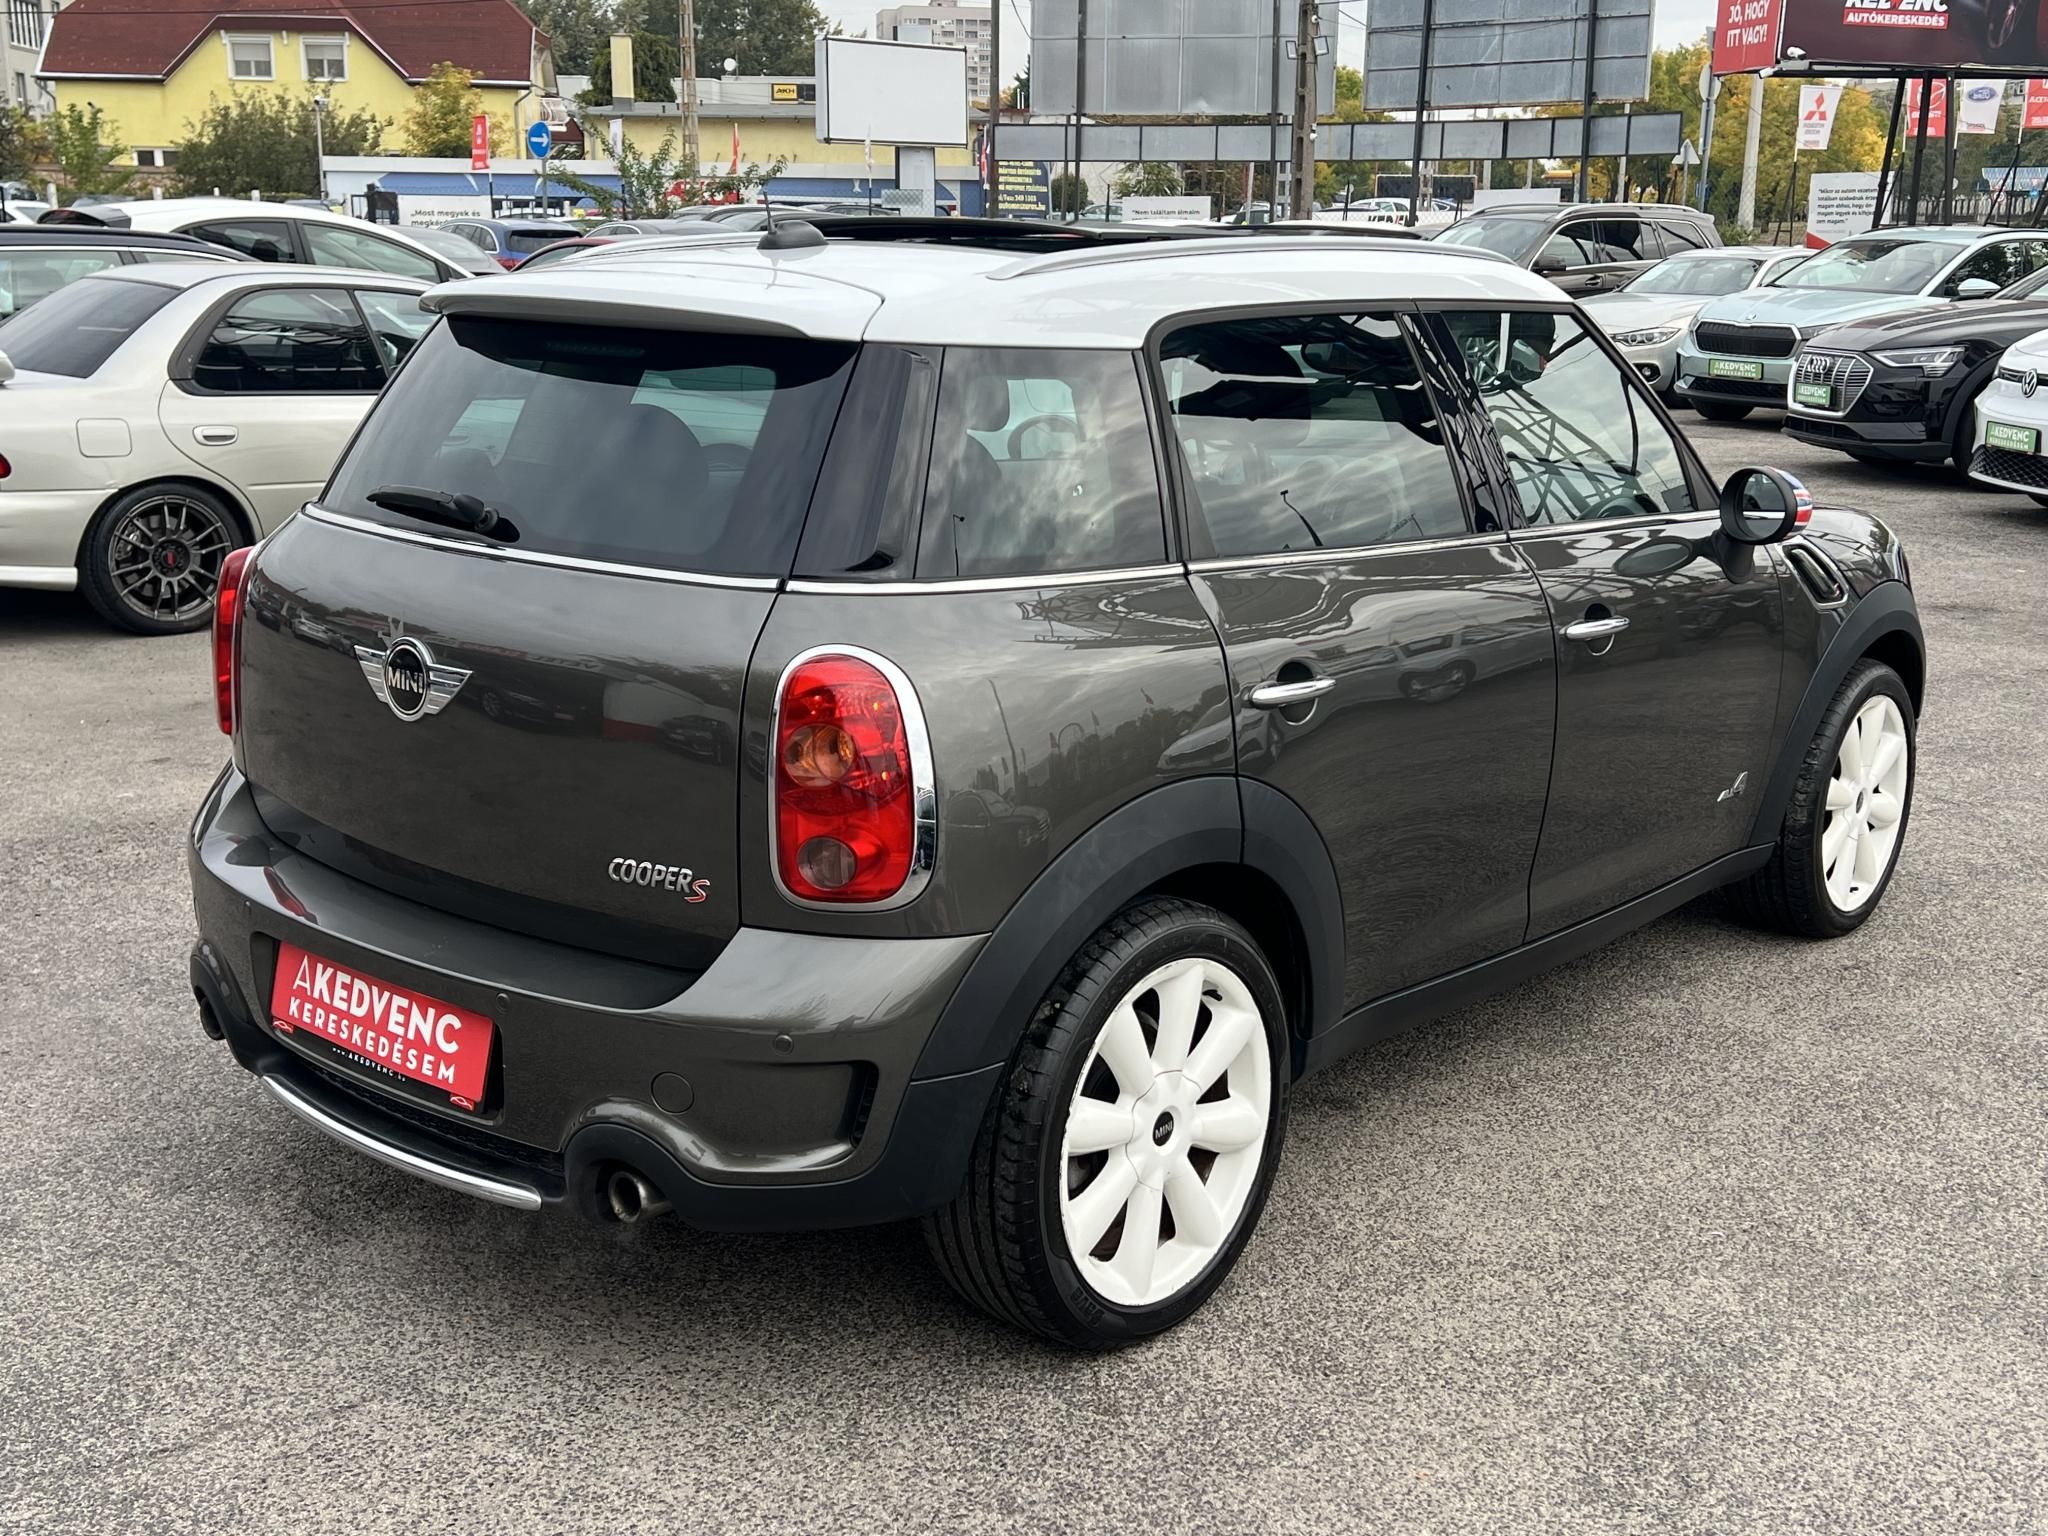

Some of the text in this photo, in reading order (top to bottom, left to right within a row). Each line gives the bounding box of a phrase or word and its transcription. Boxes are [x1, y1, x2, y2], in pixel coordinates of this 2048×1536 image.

[1744, 0, 1770, 21] HOGY
[1846, 11, 1945, 27] AUTÓKERESKEDÉS
[1727, 24, 1768, 48] ITT VAGY!
[388, 665, 424, 694] MINI
[608, 857, 711, 903] COOPER S
[288, 996, 455, 1084] KERESKEDÉSEM
[1155, 1119, 1173, 1140] MINI
